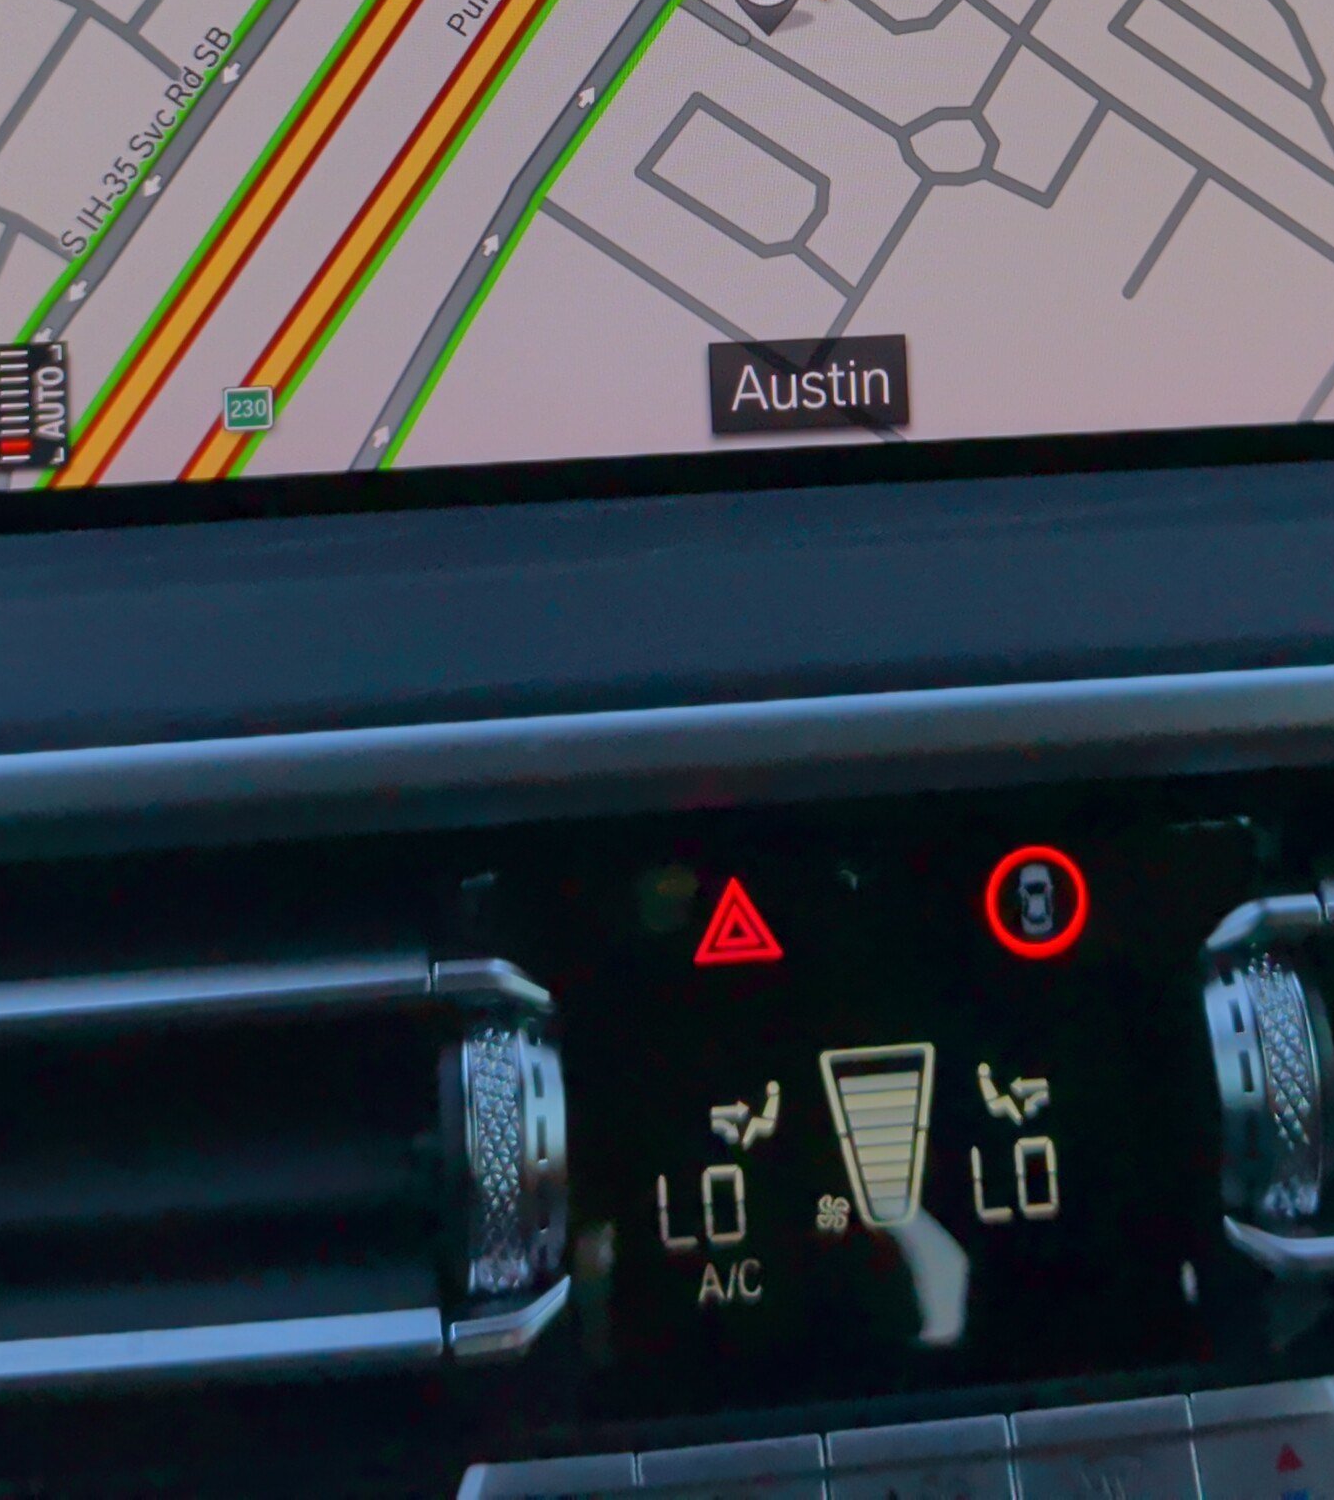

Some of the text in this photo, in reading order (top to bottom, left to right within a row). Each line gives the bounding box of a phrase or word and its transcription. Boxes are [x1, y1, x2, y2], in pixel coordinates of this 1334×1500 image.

[61, 26, 233, 255] S IH-35 Svc Rd SB
[36, 366, 65, 439] AUTO
[229, 397, 268, 420] 230
[731, 359, 891, 413] Austin
[658, 1164, 746, 1248] LO
[971, 1137, 1060, 1224] LO
[699, 1260, 763, 1303] A/C
